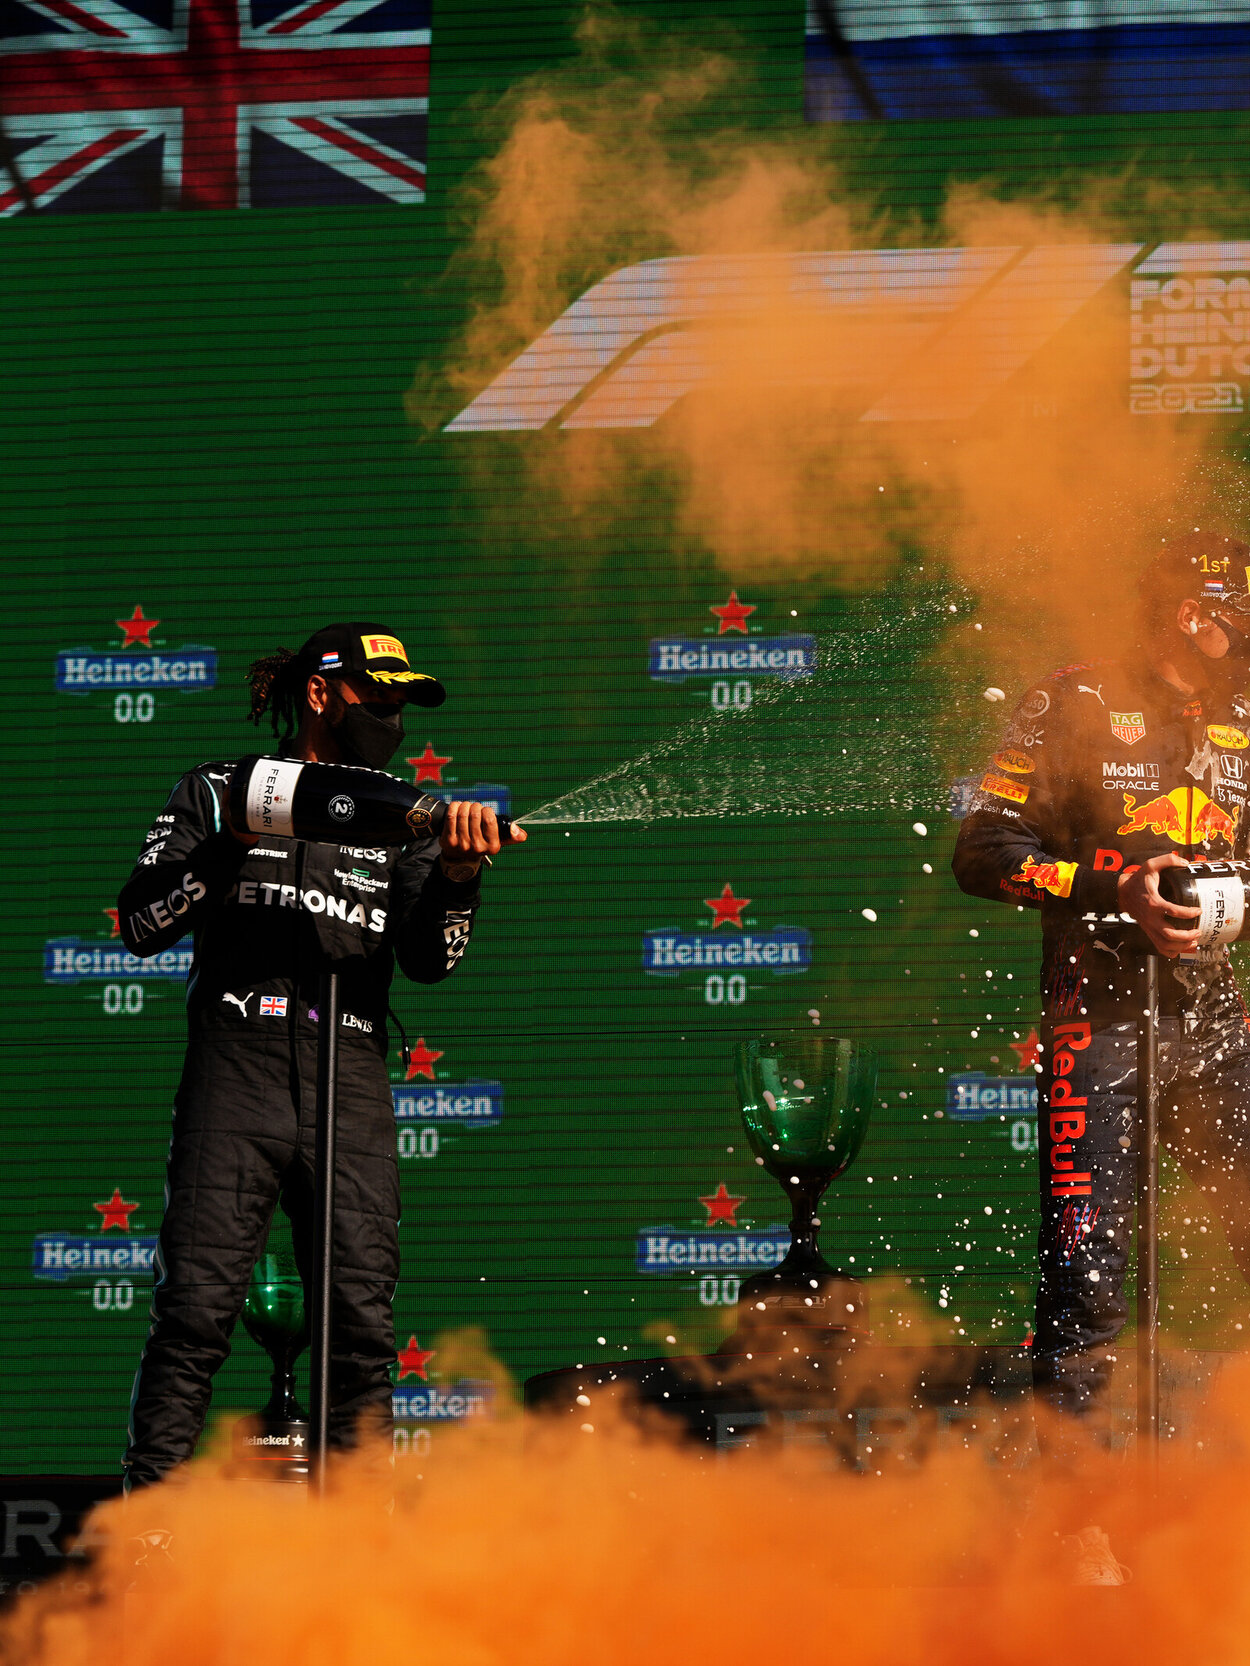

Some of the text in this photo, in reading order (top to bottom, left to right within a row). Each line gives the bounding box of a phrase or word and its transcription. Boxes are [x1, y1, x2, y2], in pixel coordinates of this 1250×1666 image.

[1130, 382, 1244, 414] 2021
[369, 639, 405, 654] PIRE
[658, 643, 805, 670] Heineken
[64, 657, 206, 684] Heineken
[1112, 714, 1141, 725] TAG
[1113, 726, 1144, 743] HEUER
[1102, 762, 1145, 778] Mobil
[1102, 780, 1160, 791] ORACLE
[1216, 777, 1248, 792] HONDA
[262, 768, 280, 828] FERRARI
[335, 802, 348, 814] 2
[248, 848, 288, 859] DSTRIKE
[340, 845, 387, 864] INEOS
[129, 872, 207, 943] INEOS
[1209, 889, 1226, 943] FERRAR
[652, 937, 800, 966] Heineken
[342, 1013, 373, 1033] LEWIS
[394, 1090, 493, 1117] neken
[957, 1083, 1039, 1109] Hein
[42, 1241, 156, 1268] Heinek
[392, 1389, 485, 1418] neken
[243, 1434, 290, 1446] Heineken
